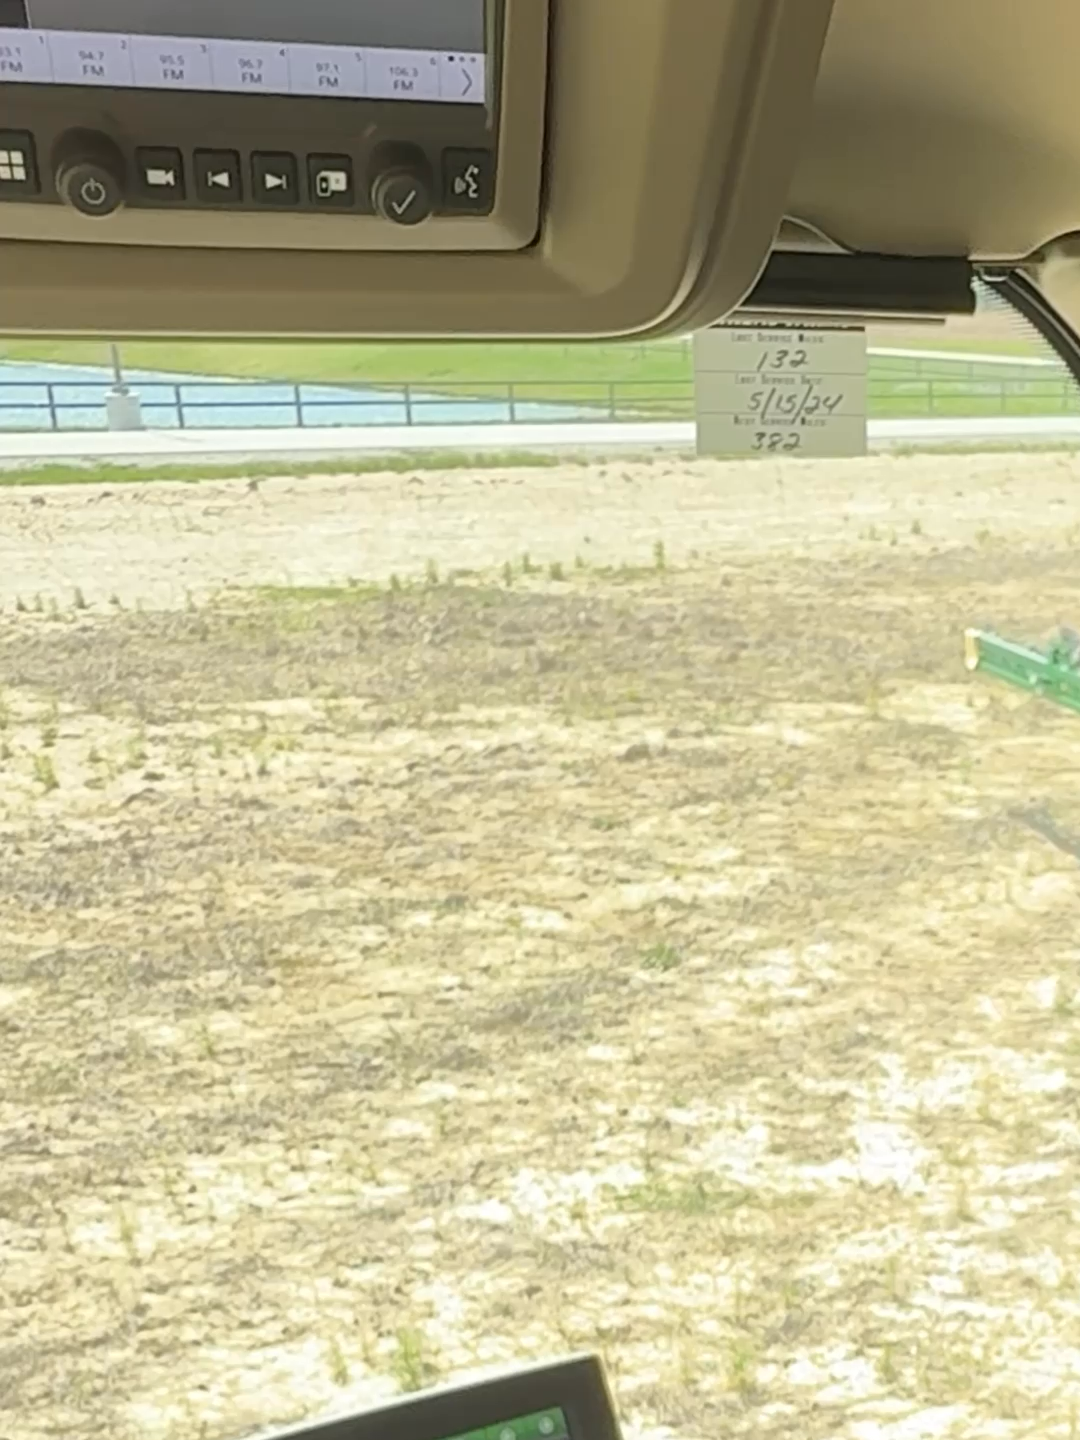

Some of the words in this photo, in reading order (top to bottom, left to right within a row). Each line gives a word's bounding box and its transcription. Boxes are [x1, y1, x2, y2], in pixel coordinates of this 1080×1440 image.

[0, 60, 23, 73] FM
[82, 65, 105, 77] FM
[162, 69, 185, 81] FM
[241, 72, 263, 84] FM
[318, 76, 340, 88] FM
[393, 79, 414, 92] FM
[756, 349, 809, 372] 132
[746, 383, 844, 425] 5/15/24
